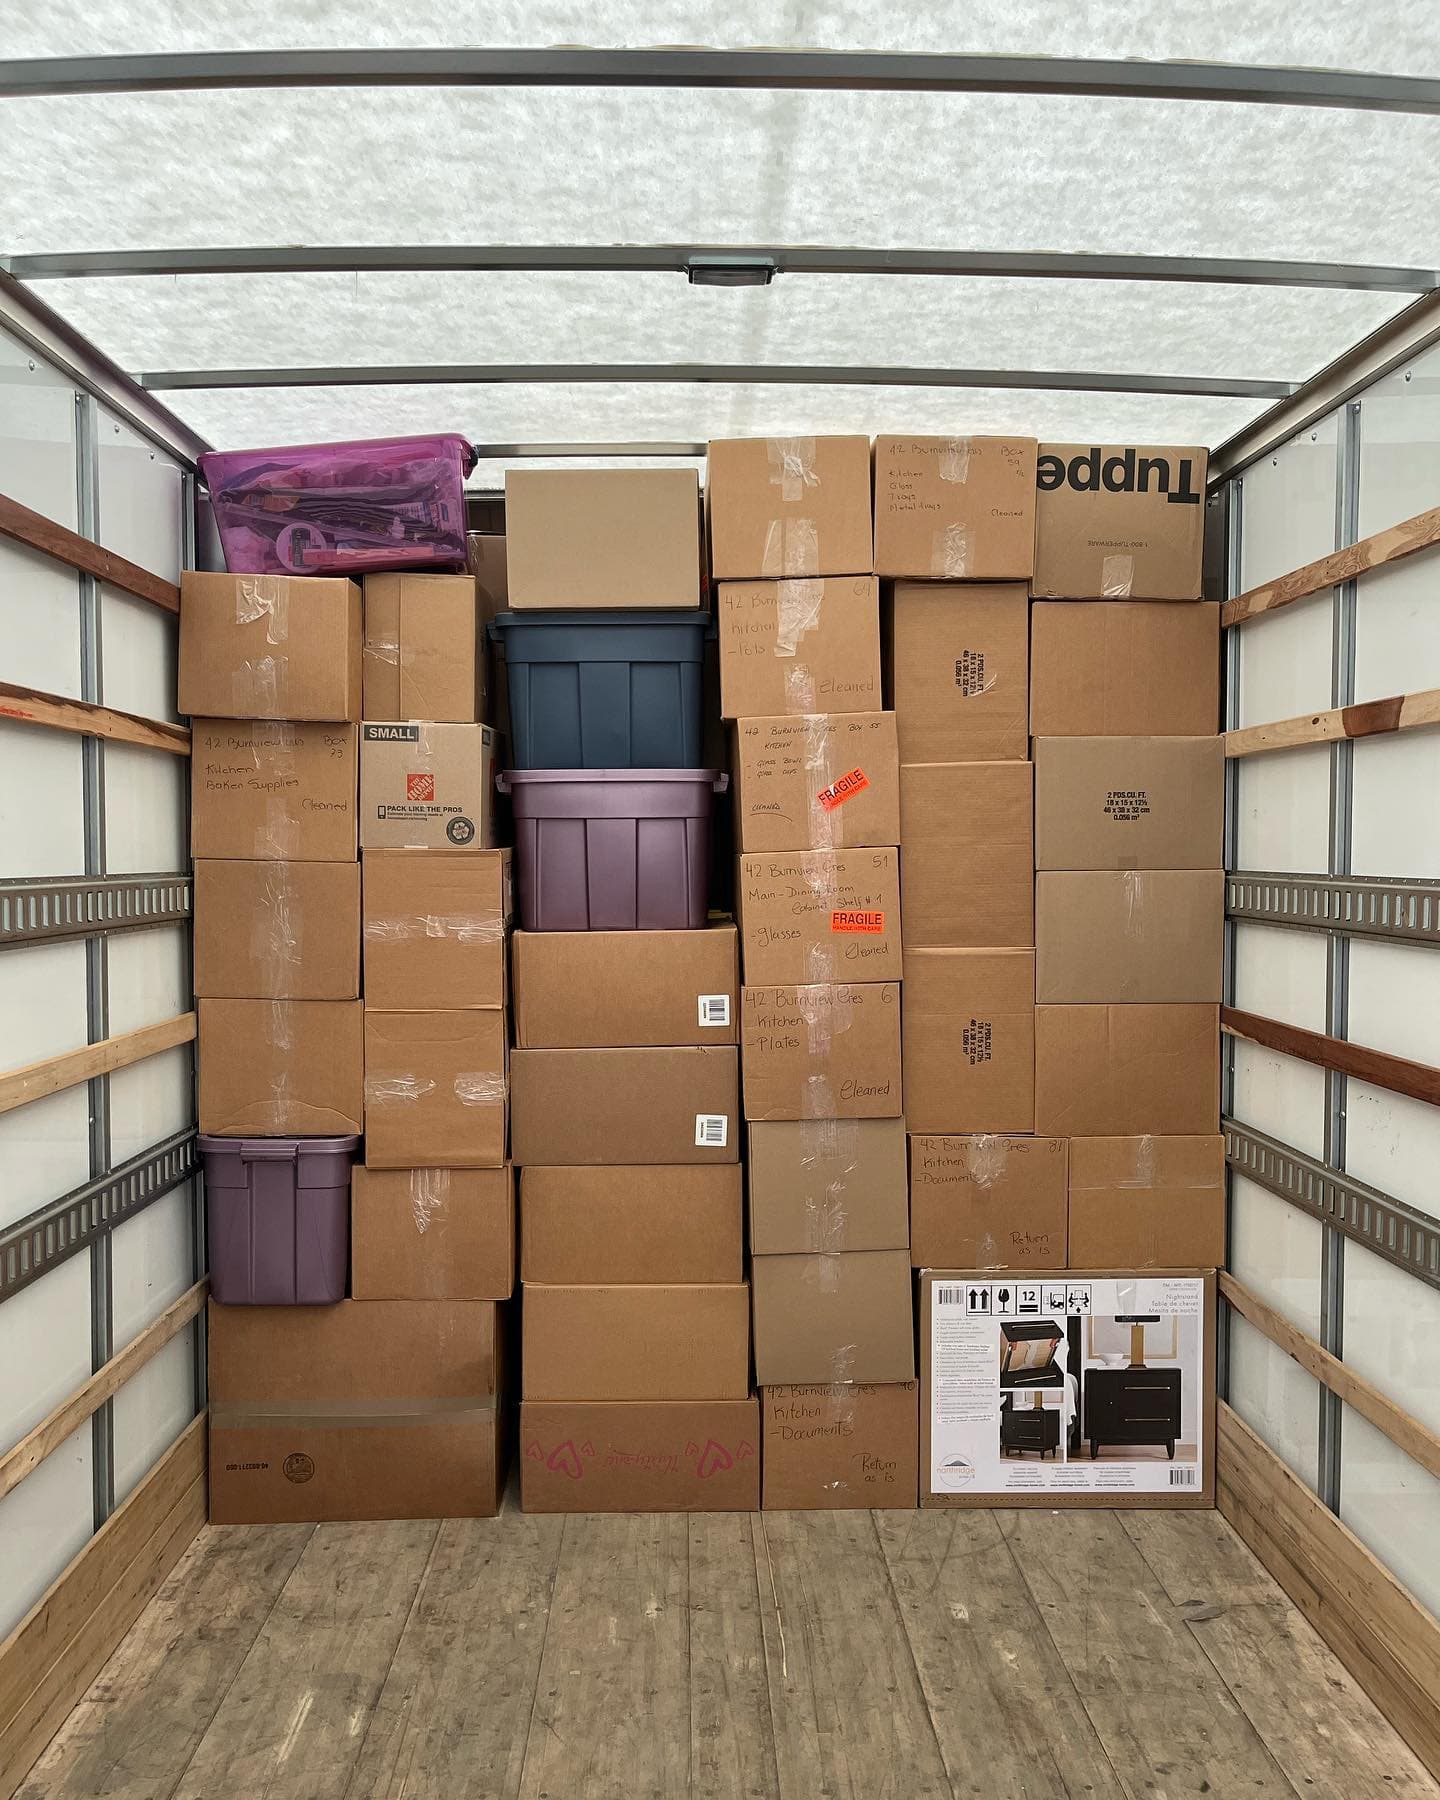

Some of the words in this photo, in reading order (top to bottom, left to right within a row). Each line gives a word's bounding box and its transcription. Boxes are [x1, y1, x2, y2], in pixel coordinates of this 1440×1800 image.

[1037, 448, 1200, 504] Tuppe
[725, 594, 743, 610] 42
[369, 727, 414, 739] SMALL
[204, 736, 222, 750] 42
[322, 735, 350, 746] Box
[248, 777, 299, 793] Supplies
[818, 769, 863, 805] FRAGILE
[302, 798, 348, 812] Cleaned
[745, 862, 761, 878] 42
[872, 855, 888, 868] 51
[833, 913, 882, 925] FRAGILE
[845, 942, 889, 960] Cleaned
[745, 989, 767, 1009] 42
[836, 985, 864, 1005] Cres
[881, 984, 893, 1004] 6
[758, 1013, 804, 1028] Kitchen
[840, 1079, 890, 1100] Cleaned
[920, 1139, 937, 1151] 42
[923, 1156, 965, 1168] Kitchen
[1009, 1231, 1049, 1245] Return
[1018, 1247, 1031, 1255] as
[1022, 1291, 1036, 1301] 12
[767, 1386, 787, 1400] 42
[774, 1401, 821, 1420] Kitchen
[852, 1452, 897, 1473] Return
[884, 1472, 895, 1482] is
